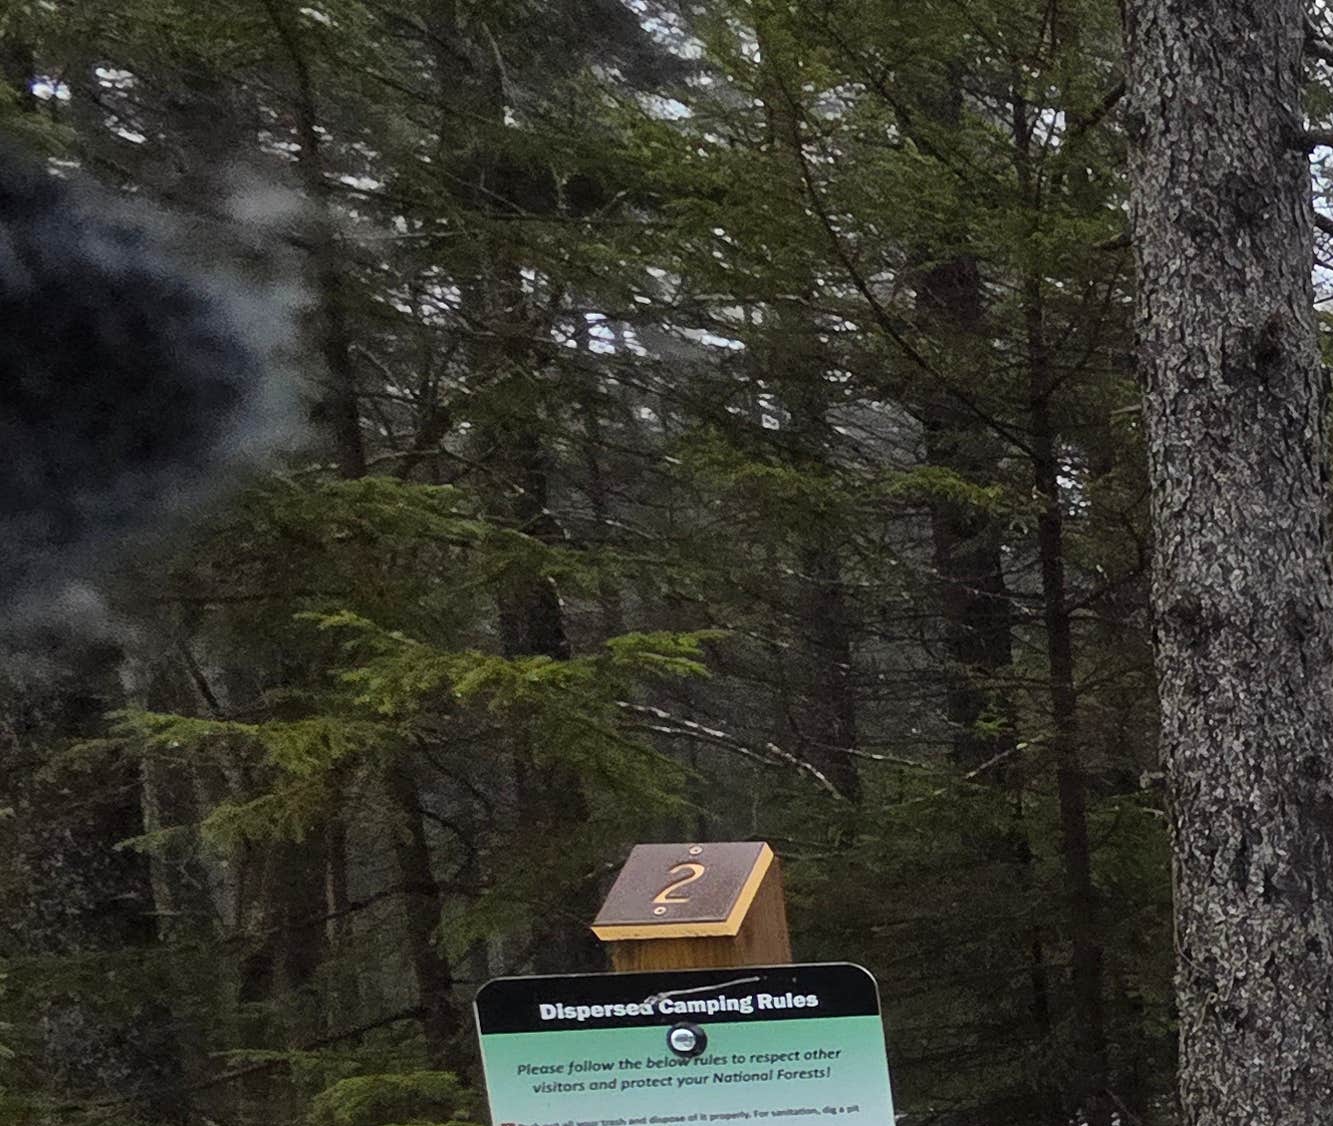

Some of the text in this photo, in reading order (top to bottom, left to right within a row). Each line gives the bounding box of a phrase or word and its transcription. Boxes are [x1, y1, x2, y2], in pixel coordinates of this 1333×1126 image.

[652, 863, 705, 904] 2
[539, 992, 819, 1021] Dispersed Camping Rules
[517, 1048, 842, 1076] Please follow the below rules to respect other
[533, 1066, 831, 1093] visitors and protect your National Forests!
